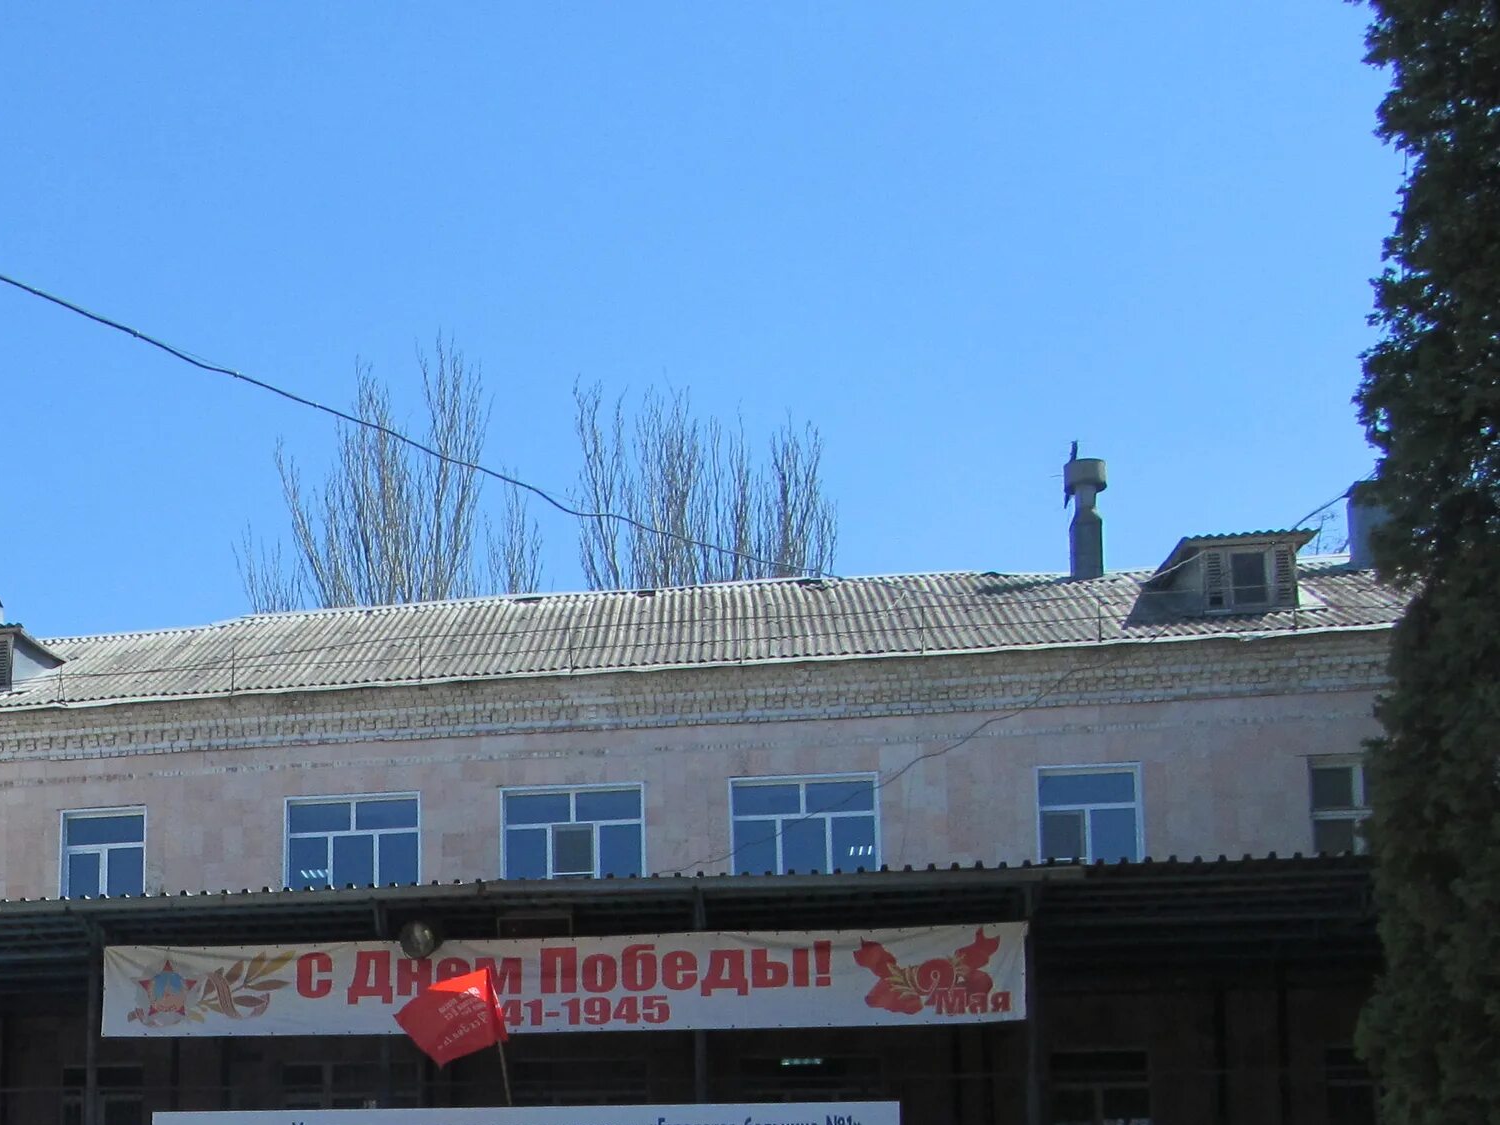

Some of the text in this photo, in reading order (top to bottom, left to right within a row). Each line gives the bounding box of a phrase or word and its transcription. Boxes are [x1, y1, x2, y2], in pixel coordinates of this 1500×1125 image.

[296, 951, 333, 998] С
[540, 941, 832, 997] Победы!
[501, 994, 671, 1027] 41-1945
[934, 987, 1012, 1016] Мая
